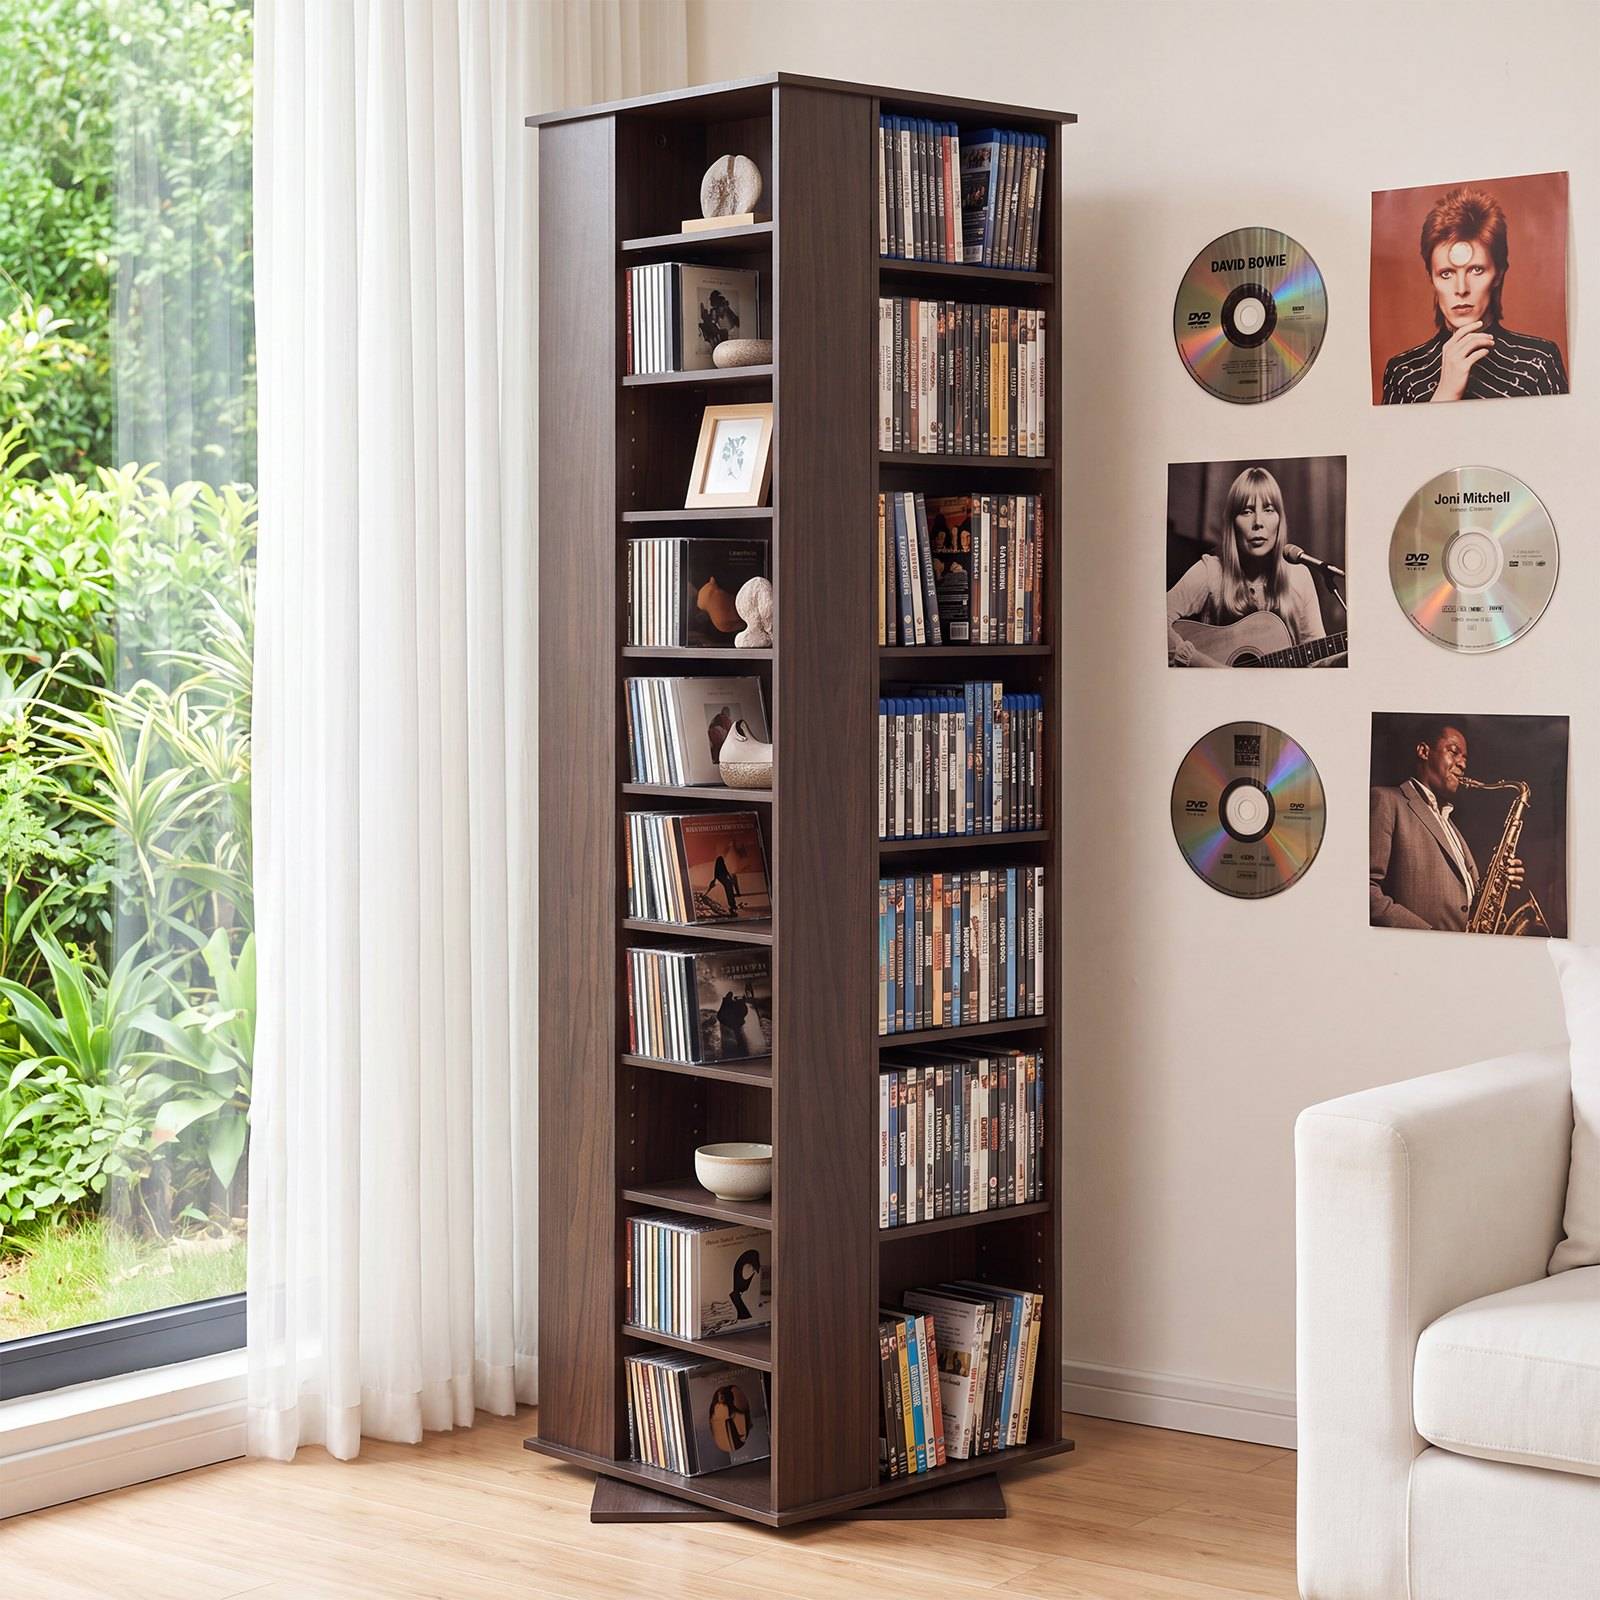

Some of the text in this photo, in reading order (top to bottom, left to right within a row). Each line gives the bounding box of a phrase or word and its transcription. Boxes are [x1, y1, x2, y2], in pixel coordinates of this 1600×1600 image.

[1211, 254, 1287, 272] DAVID BOWIE
[1188, 311, 1211, 321] DVD
[1434, 491, 1510, 505] Joni Mitchell
[1405, 553, 1430, 562] DVD
[1186, 800, 1209, 808] DVD
